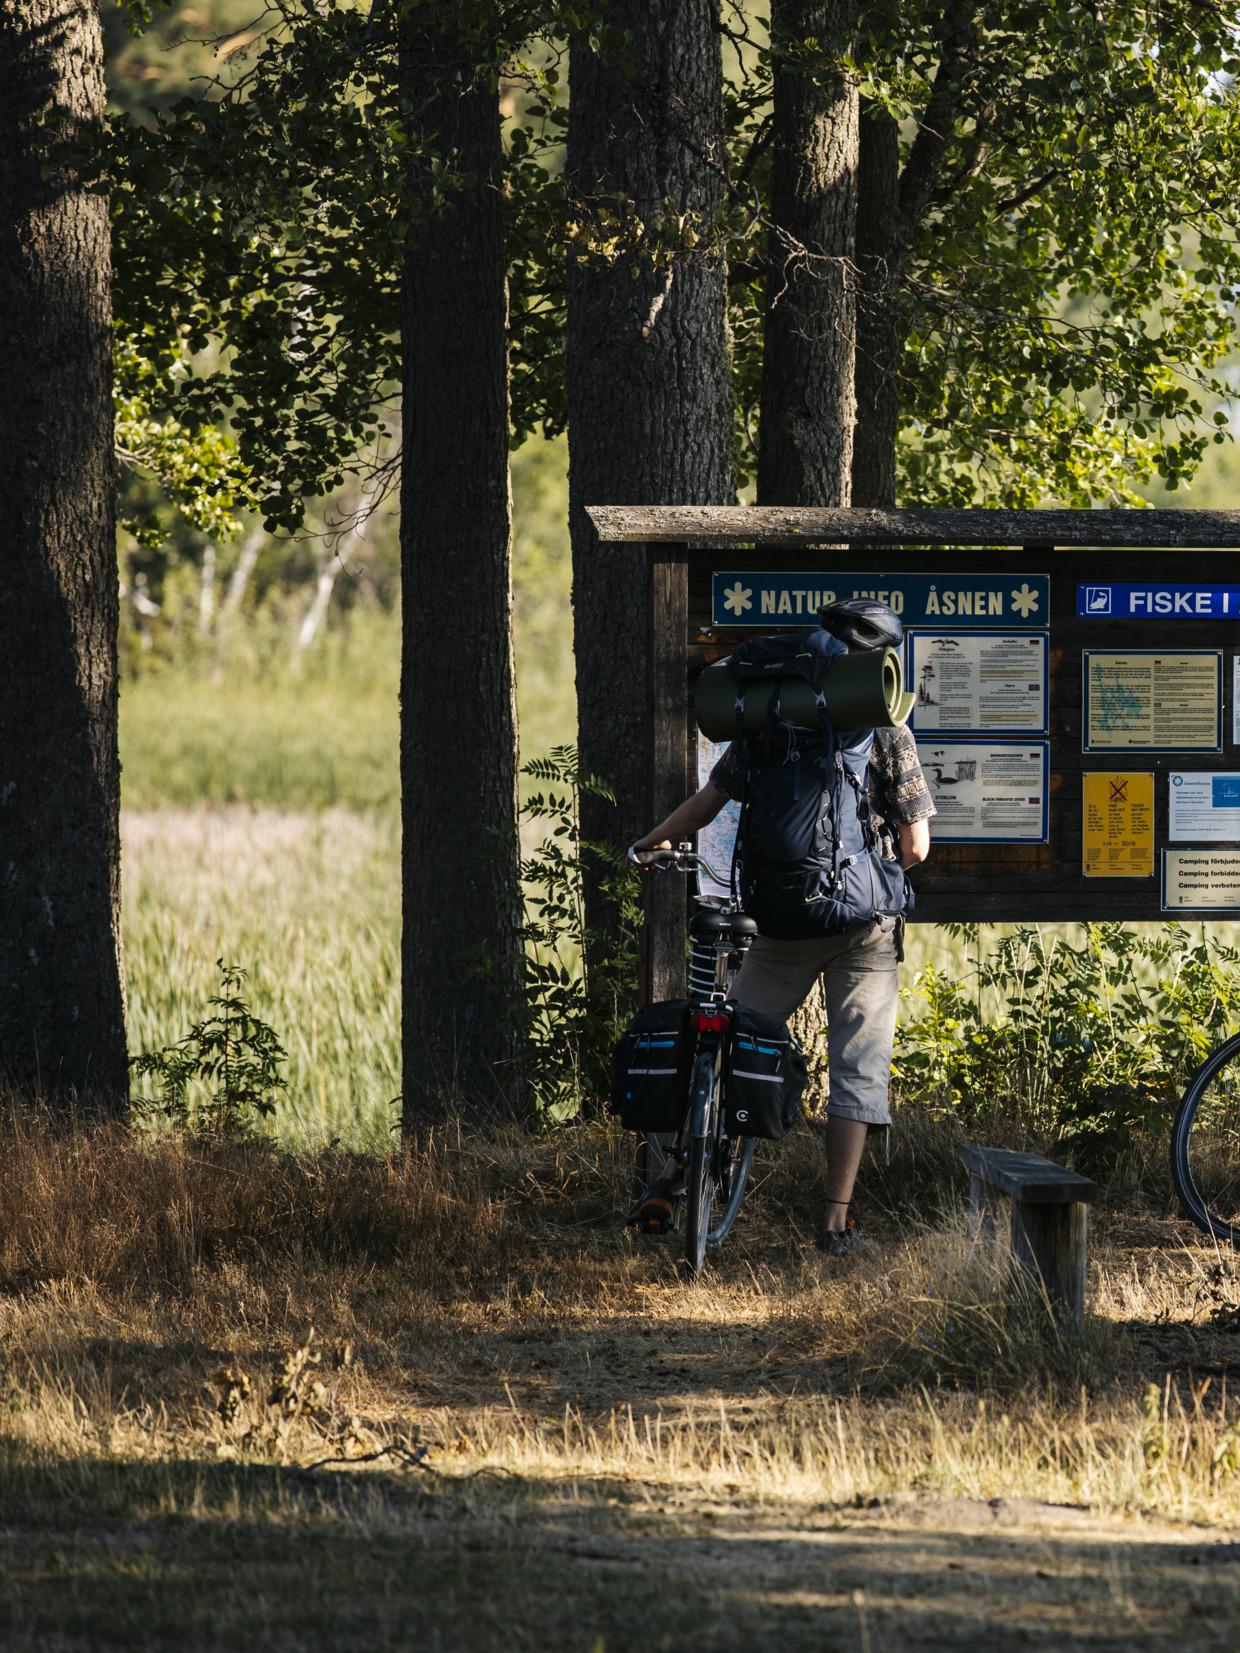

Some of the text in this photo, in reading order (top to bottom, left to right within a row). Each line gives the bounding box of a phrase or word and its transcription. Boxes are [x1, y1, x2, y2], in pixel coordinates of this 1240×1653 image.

[925, 585, 1003, 615] ÅSNEN
[1129, 592, 1212, 613] FISKE
[1223, 592, 1229, 613] I
